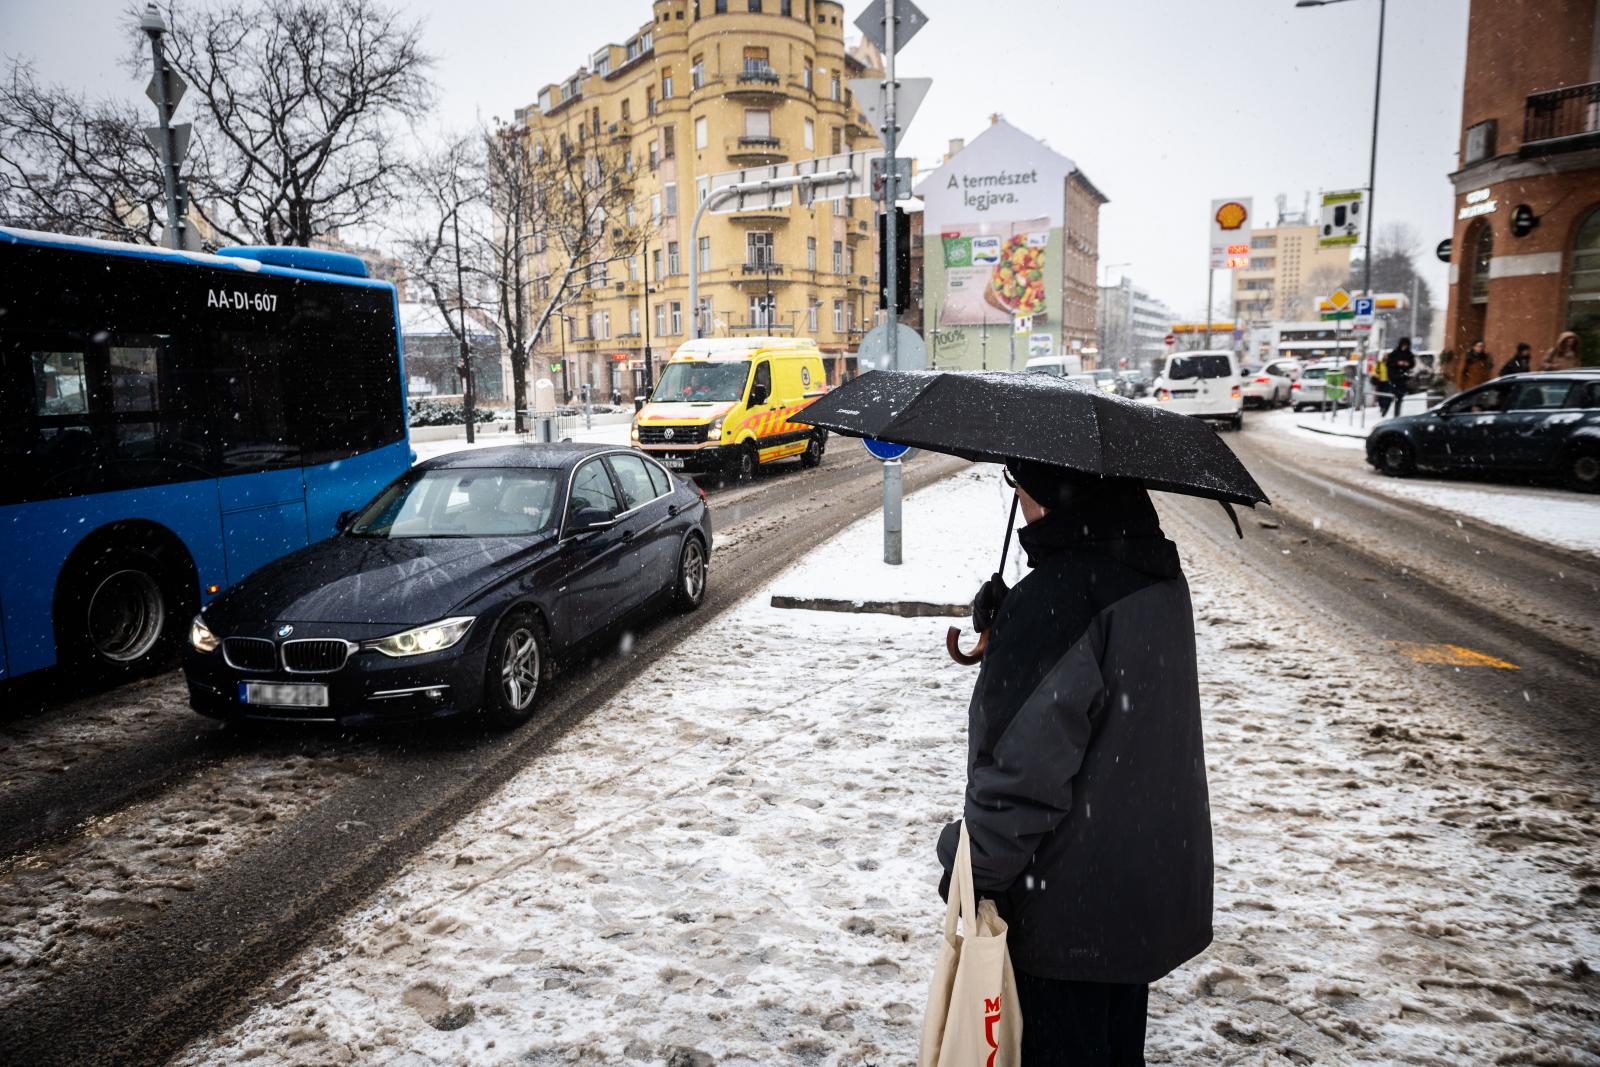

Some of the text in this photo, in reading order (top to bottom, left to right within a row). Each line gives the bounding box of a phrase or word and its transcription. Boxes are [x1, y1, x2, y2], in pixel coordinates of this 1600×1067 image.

[946, 169, 1037, 190] A természet
[964, 189, 1019, 211] legjava.
[207, 288, 278, 313] AA-DI-607
[1357, 300, 1371, 315] P
[935, 330, 965, 345] 100%
